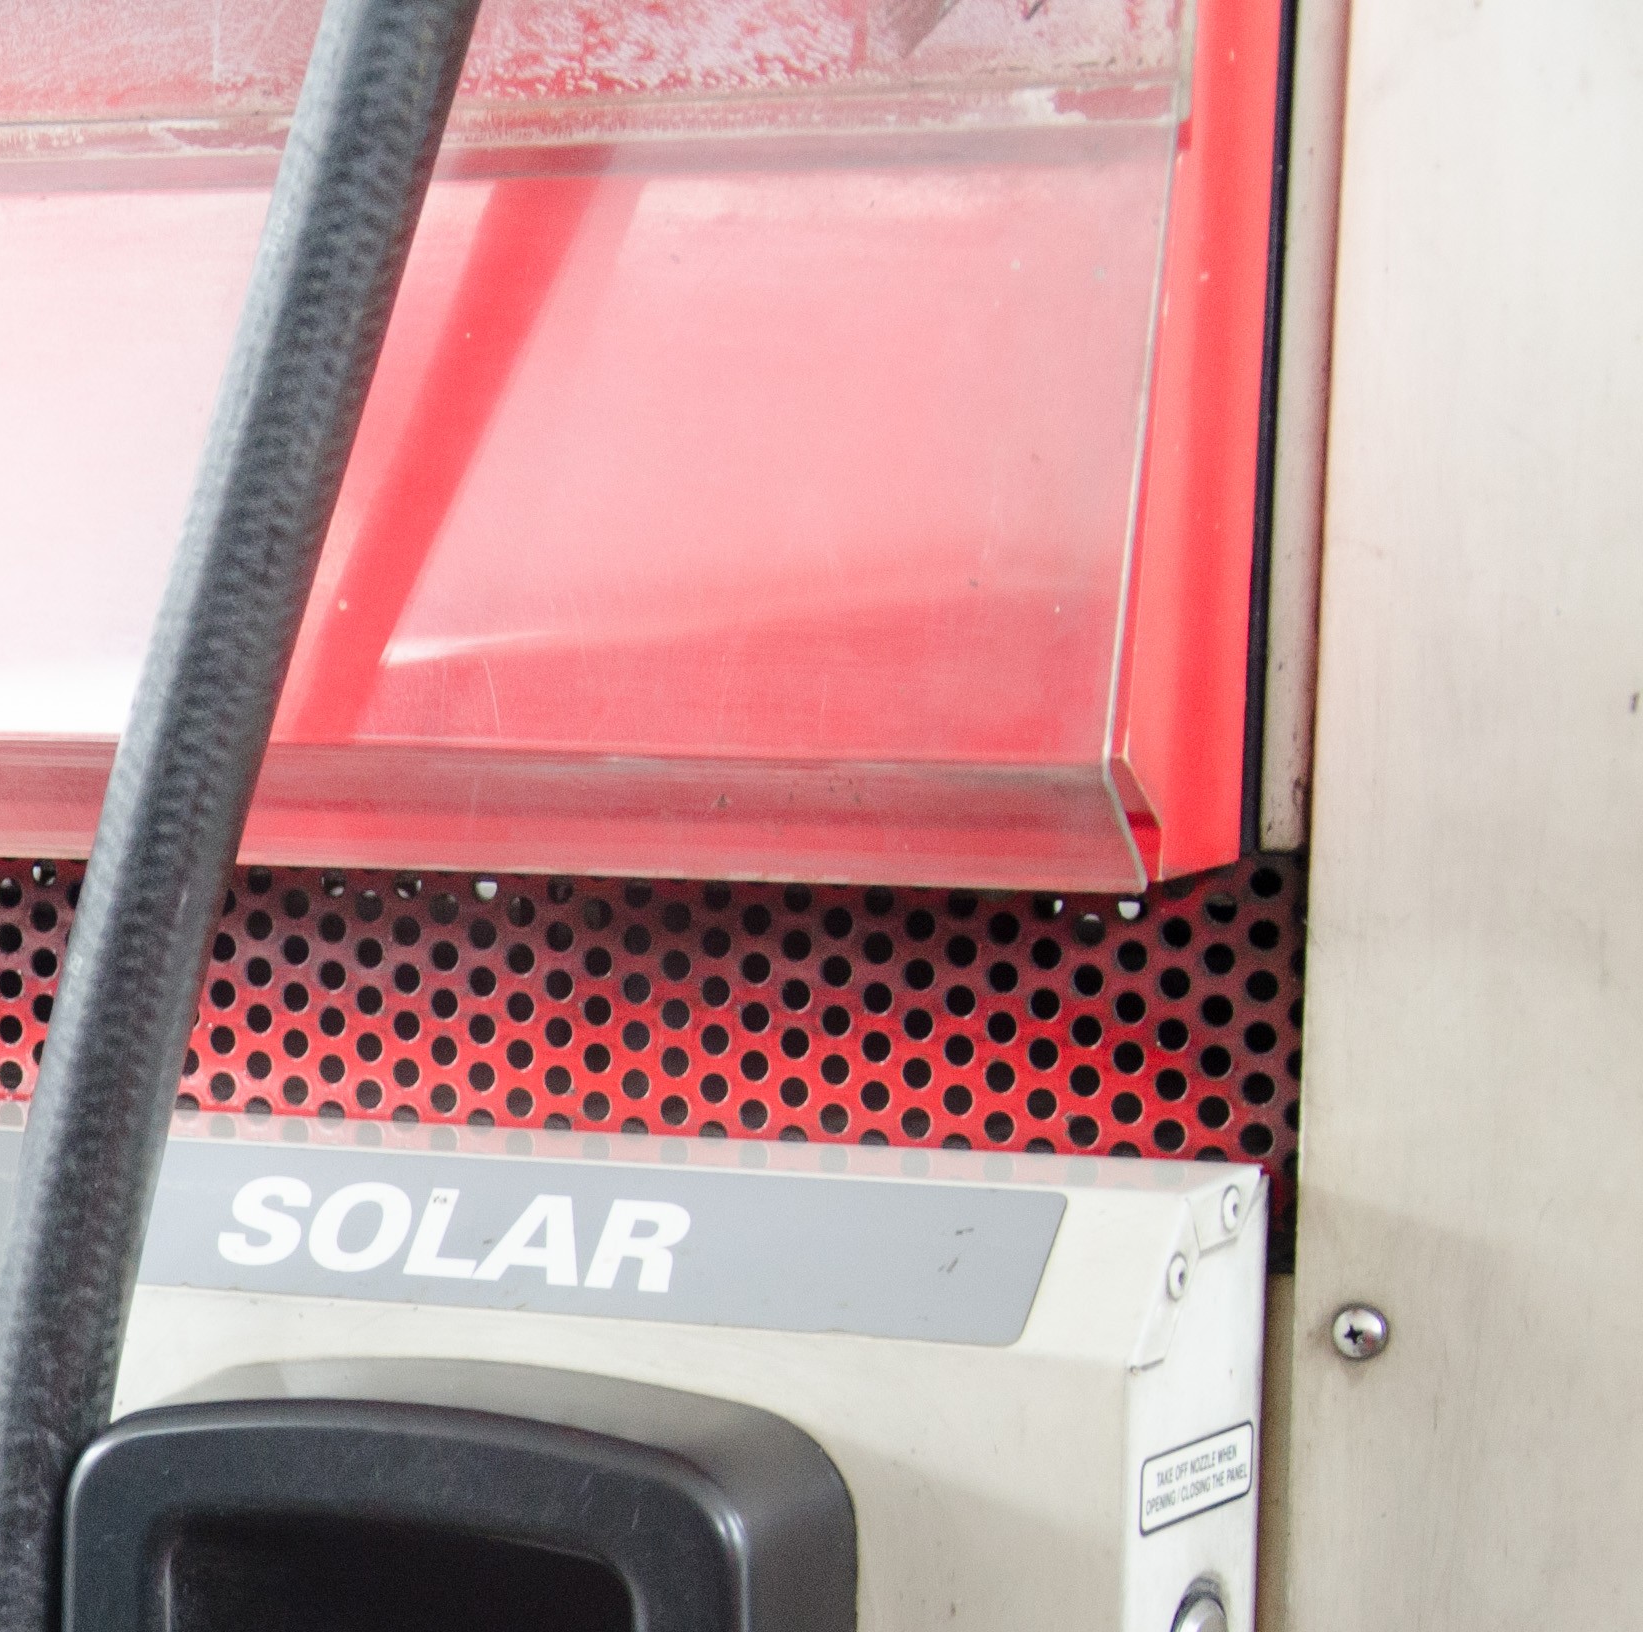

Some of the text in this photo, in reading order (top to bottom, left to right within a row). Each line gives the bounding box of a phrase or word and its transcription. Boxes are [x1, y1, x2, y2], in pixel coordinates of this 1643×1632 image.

[217, 1175, 692, 1294] SOLAR
[1145, 1489, 1176, 1516] OPENING
[1180, 1476, 1211, 1503] CLOSING
[1212, 1473, 1225, 1490] THE
[1226, 1463, 1248, 1485] PANEL
[1156, 1443, 1238, 1488] TAKE OFF NOZZLE WHEN
